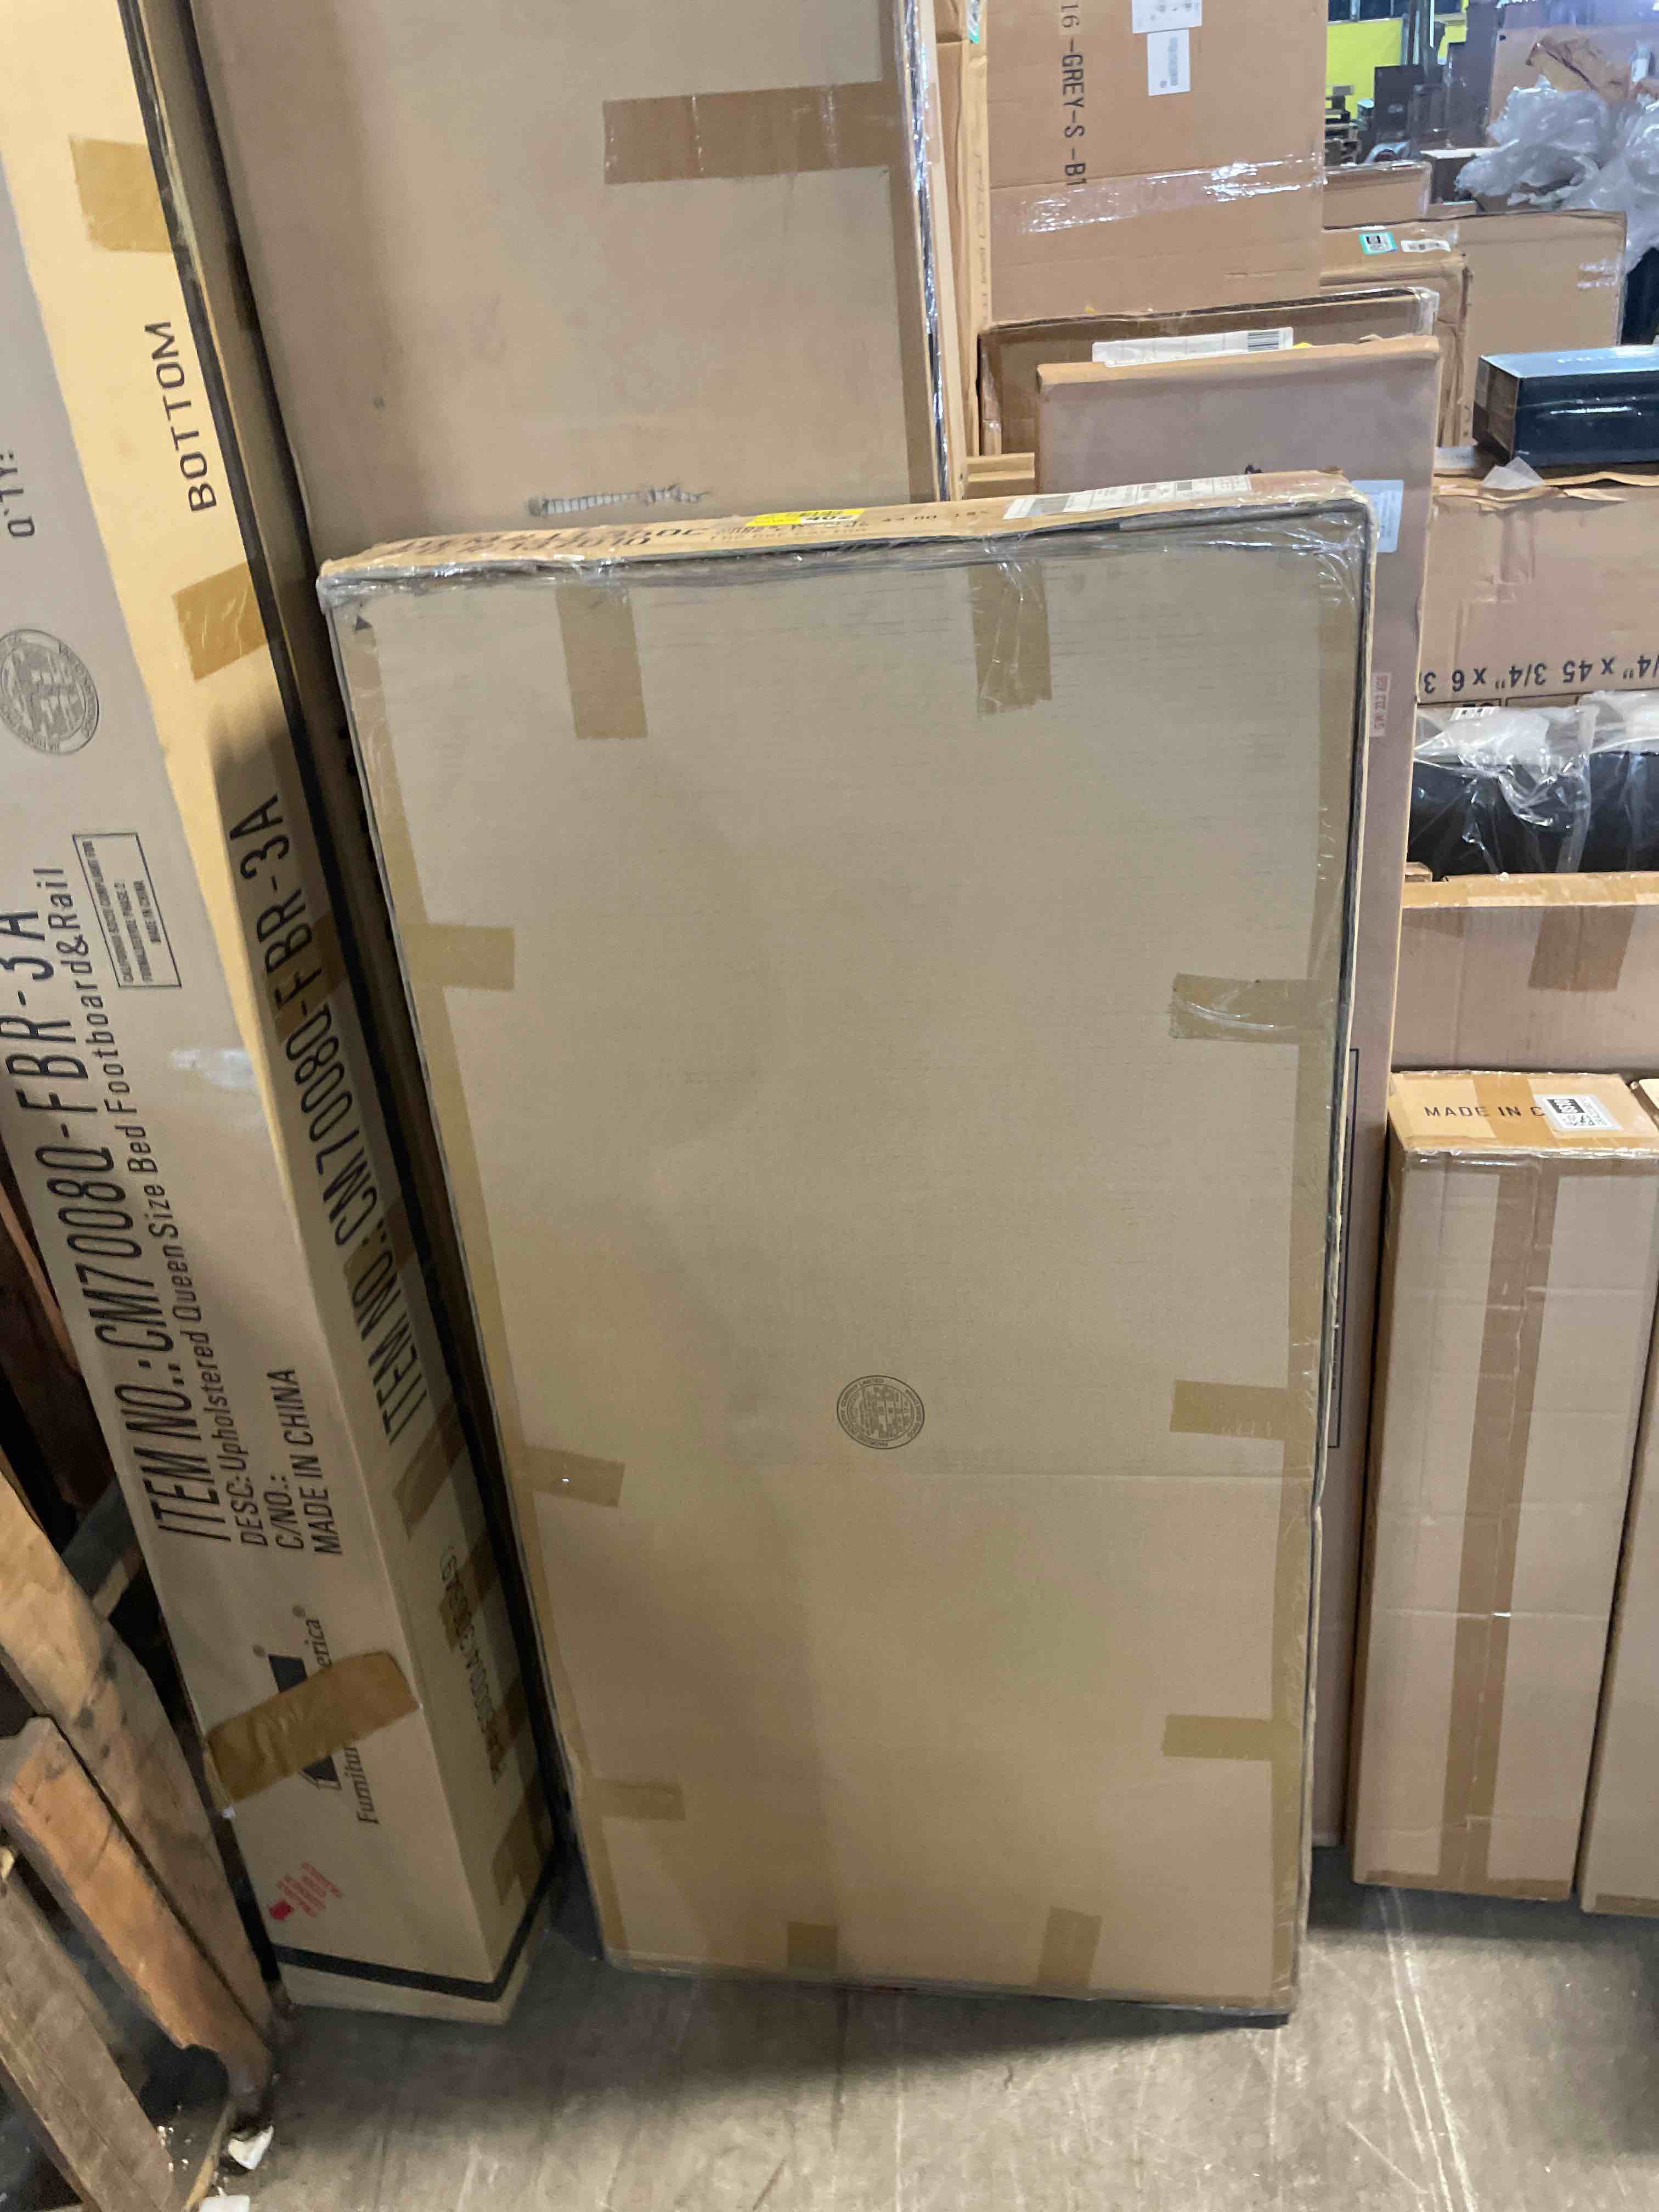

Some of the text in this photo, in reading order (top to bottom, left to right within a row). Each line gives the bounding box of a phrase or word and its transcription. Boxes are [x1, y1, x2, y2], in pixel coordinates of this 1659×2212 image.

[144, 321, 217, 512] BOTTOM
[1451, 669, 1465, 692] 6
[1472, 668, 1488, 686] x
[1494, 663, 1548, 690] 3/4"
[1562, 660, 1593, 684] 45
[1601, 656, 1616, 675] x
[1424, 1105, 1489, 1117] MADE
[1497, 1105, 1522, 1117] IN
[33, 867, 268, 1548] DESC: Upholstered Queen Size Bed Footboard&Rail
[115, 1359, 202, 1441] NO.:
[368, 1312, 427, 1446] ITEM
[267, 1368, 344, 1556] MADE IN CHINA
[133, 1449, 232, 1543] ITEM
[263, 1474, 305, 1550] C/NO.:
[305, 1615, 335, 1669] erica
